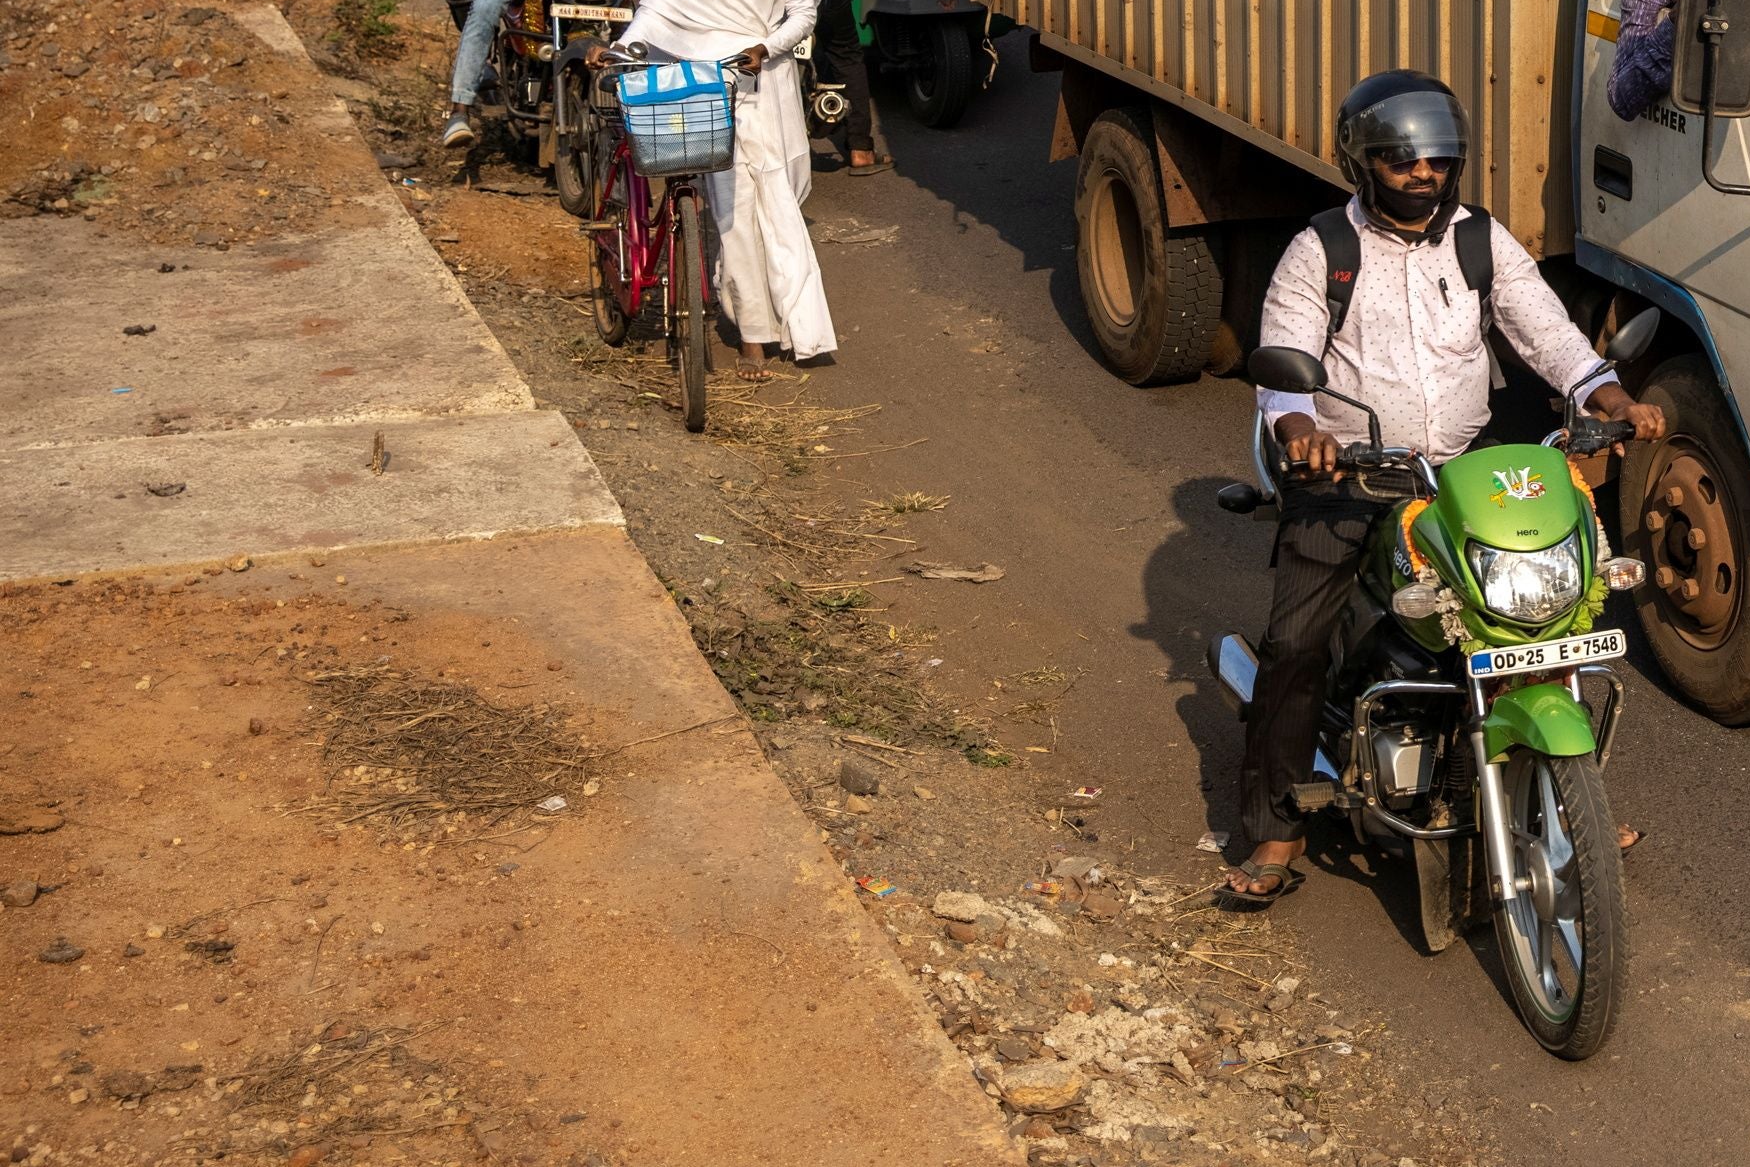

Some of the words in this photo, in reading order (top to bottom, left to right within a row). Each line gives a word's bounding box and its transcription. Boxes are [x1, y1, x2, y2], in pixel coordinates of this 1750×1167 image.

[1516, 528, 1539, 537] Hero
[1494, 652, 1518, 670] OD
[1526, 648, 1544, 666] 25
[1559, 643, 1570, 660] E
[1584, 636, 1619, 657] 7548
[1474, 666, 1491, 675] IND
